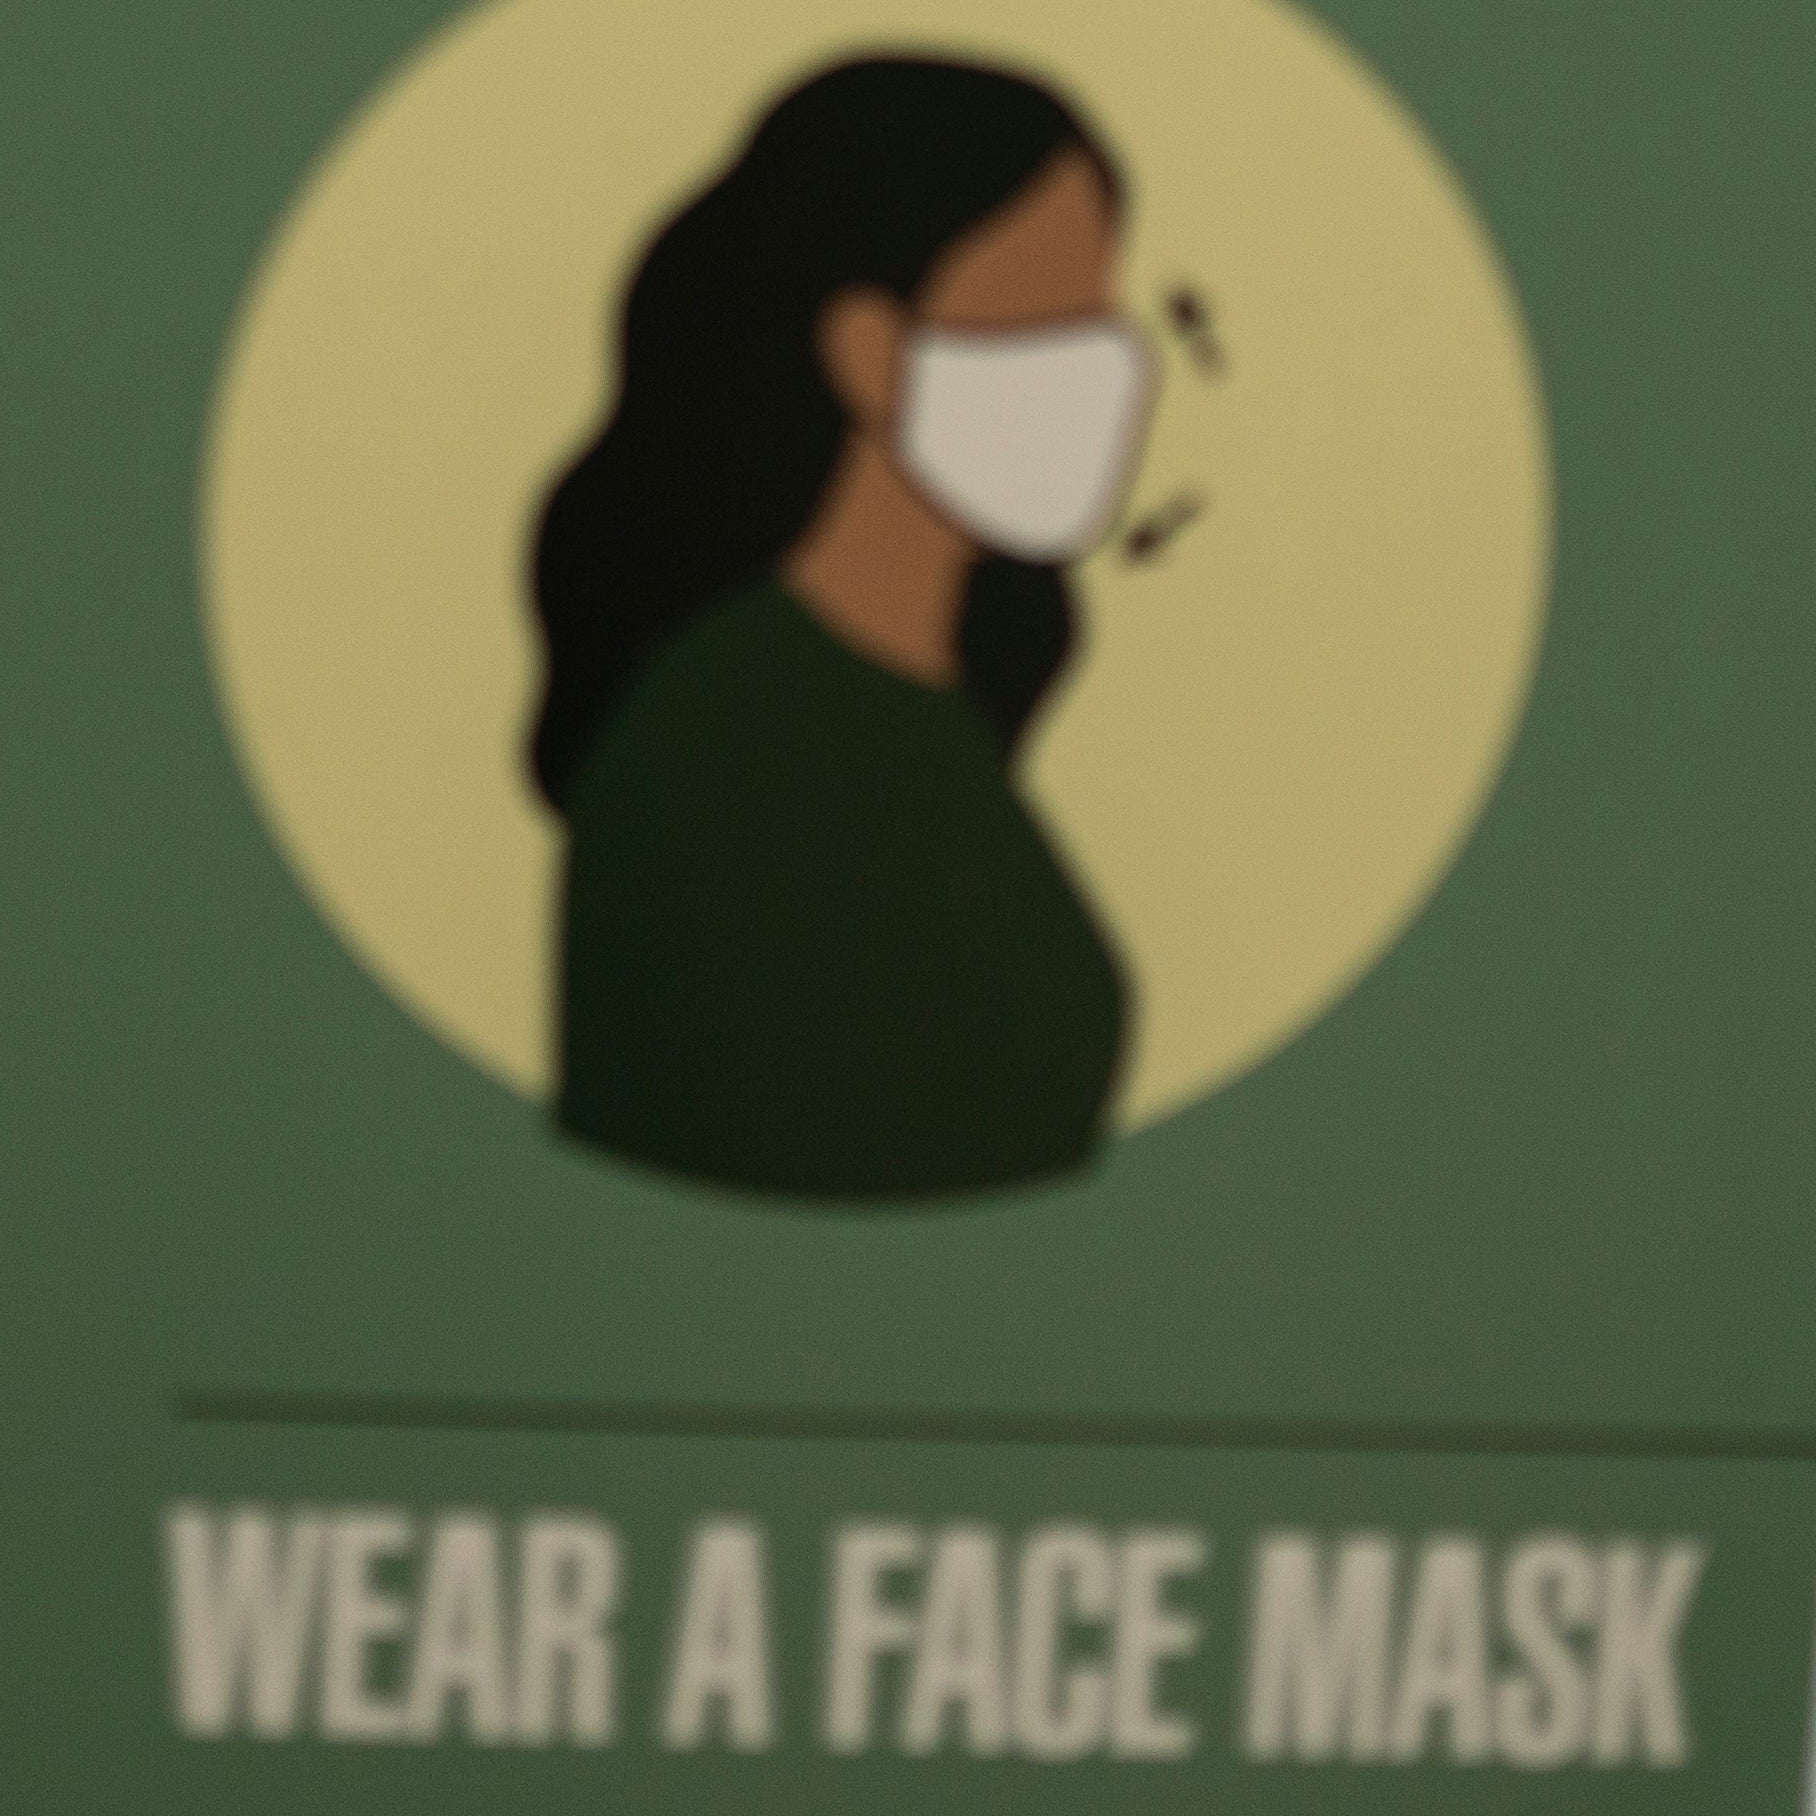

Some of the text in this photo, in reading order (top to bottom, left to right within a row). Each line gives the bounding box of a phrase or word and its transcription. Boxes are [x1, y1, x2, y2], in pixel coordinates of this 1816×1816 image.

[168, 1508, 1700, 1768] WEAR A FACE MASK
